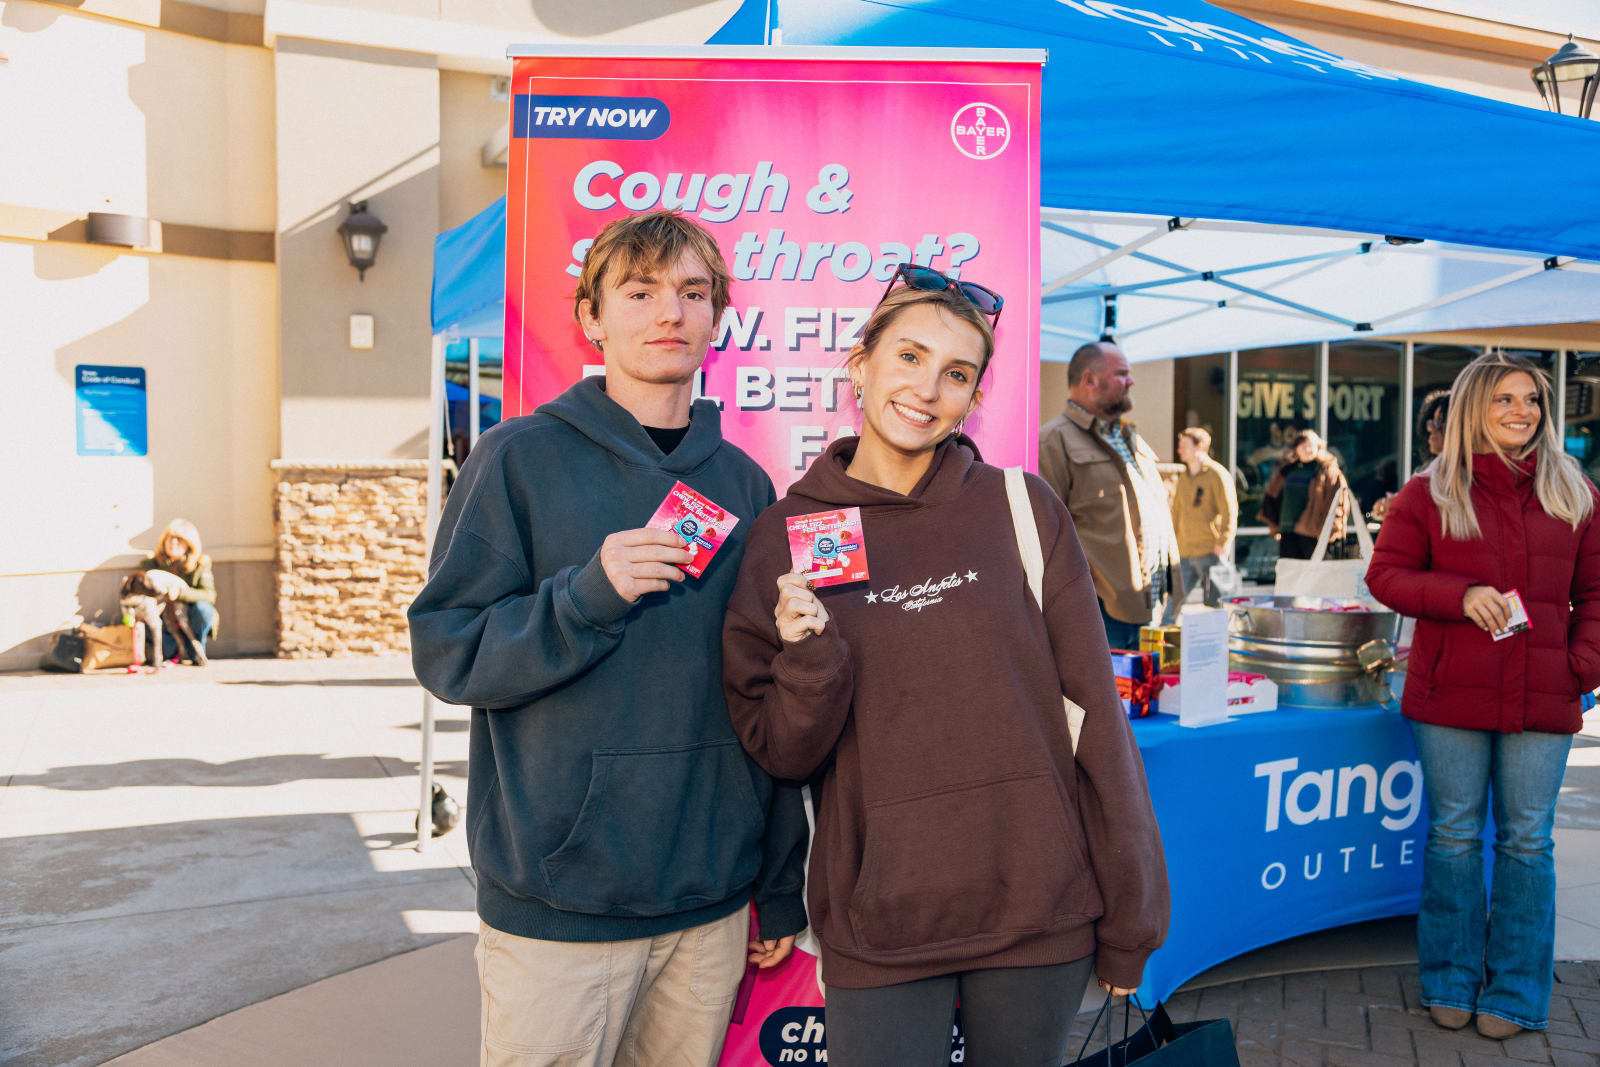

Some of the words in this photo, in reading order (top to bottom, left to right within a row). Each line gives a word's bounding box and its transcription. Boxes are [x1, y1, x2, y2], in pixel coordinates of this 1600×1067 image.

[534, 106, 586, 126] TRY
[587, 108, 657, 127] NOW
[956, 125, 1006, 137] BAYER
[976, 107, 986, 155] BAYER
[573, 160, 789, 223] Cough
[806, 163, 853, 214] &
[733, 229, 980, 282] throat?
[784, 306, 873, 352] FIZ
[1237, 381, 1295, 420] GIVE
[881, 584, 908, 603] Los
[909, 572, 963, 597] Angeles
[1254, 756, 1424, 832] Tang
[1261, 839, 1415, 890] OUTLE
[778, 1048, 809, 1063] no
